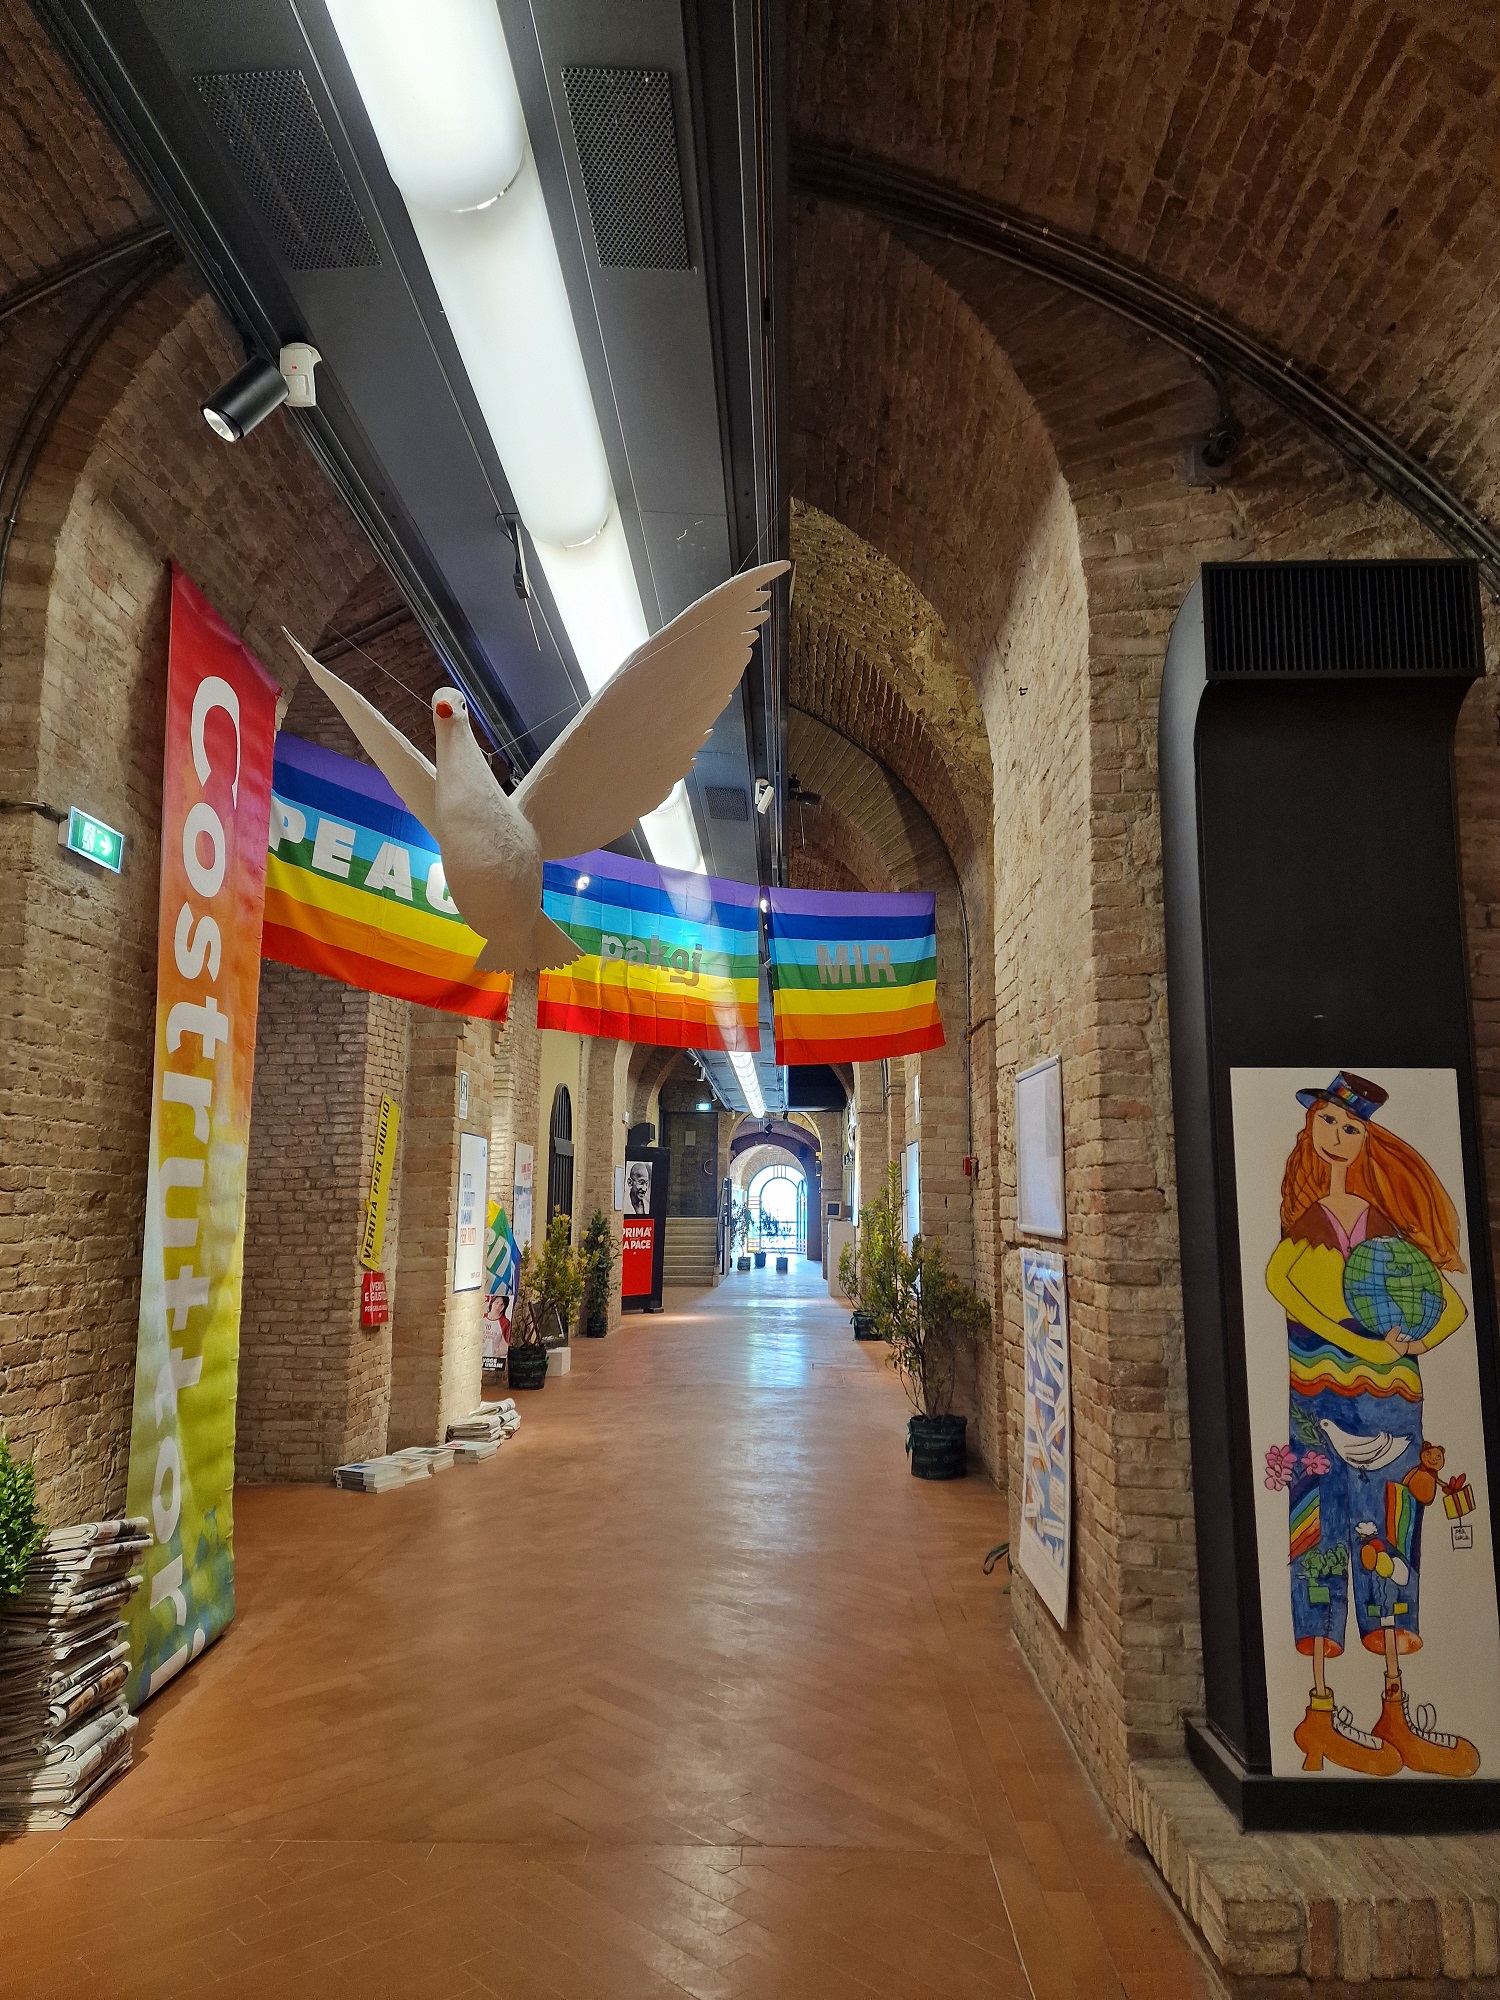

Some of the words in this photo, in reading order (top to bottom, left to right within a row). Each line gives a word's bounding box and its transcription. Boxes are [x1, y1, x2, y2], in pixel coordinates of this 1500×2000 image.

[815, 944, 897, 985] MIR
[377, 1101, 390, 1155] GIULIO
[147, 676, 241, 1700] Costruttori
[373, 1160, 382, 1195] PER
[630, 1239, 651, 1250] PACE
[364, 1292, 370, 1302] E
